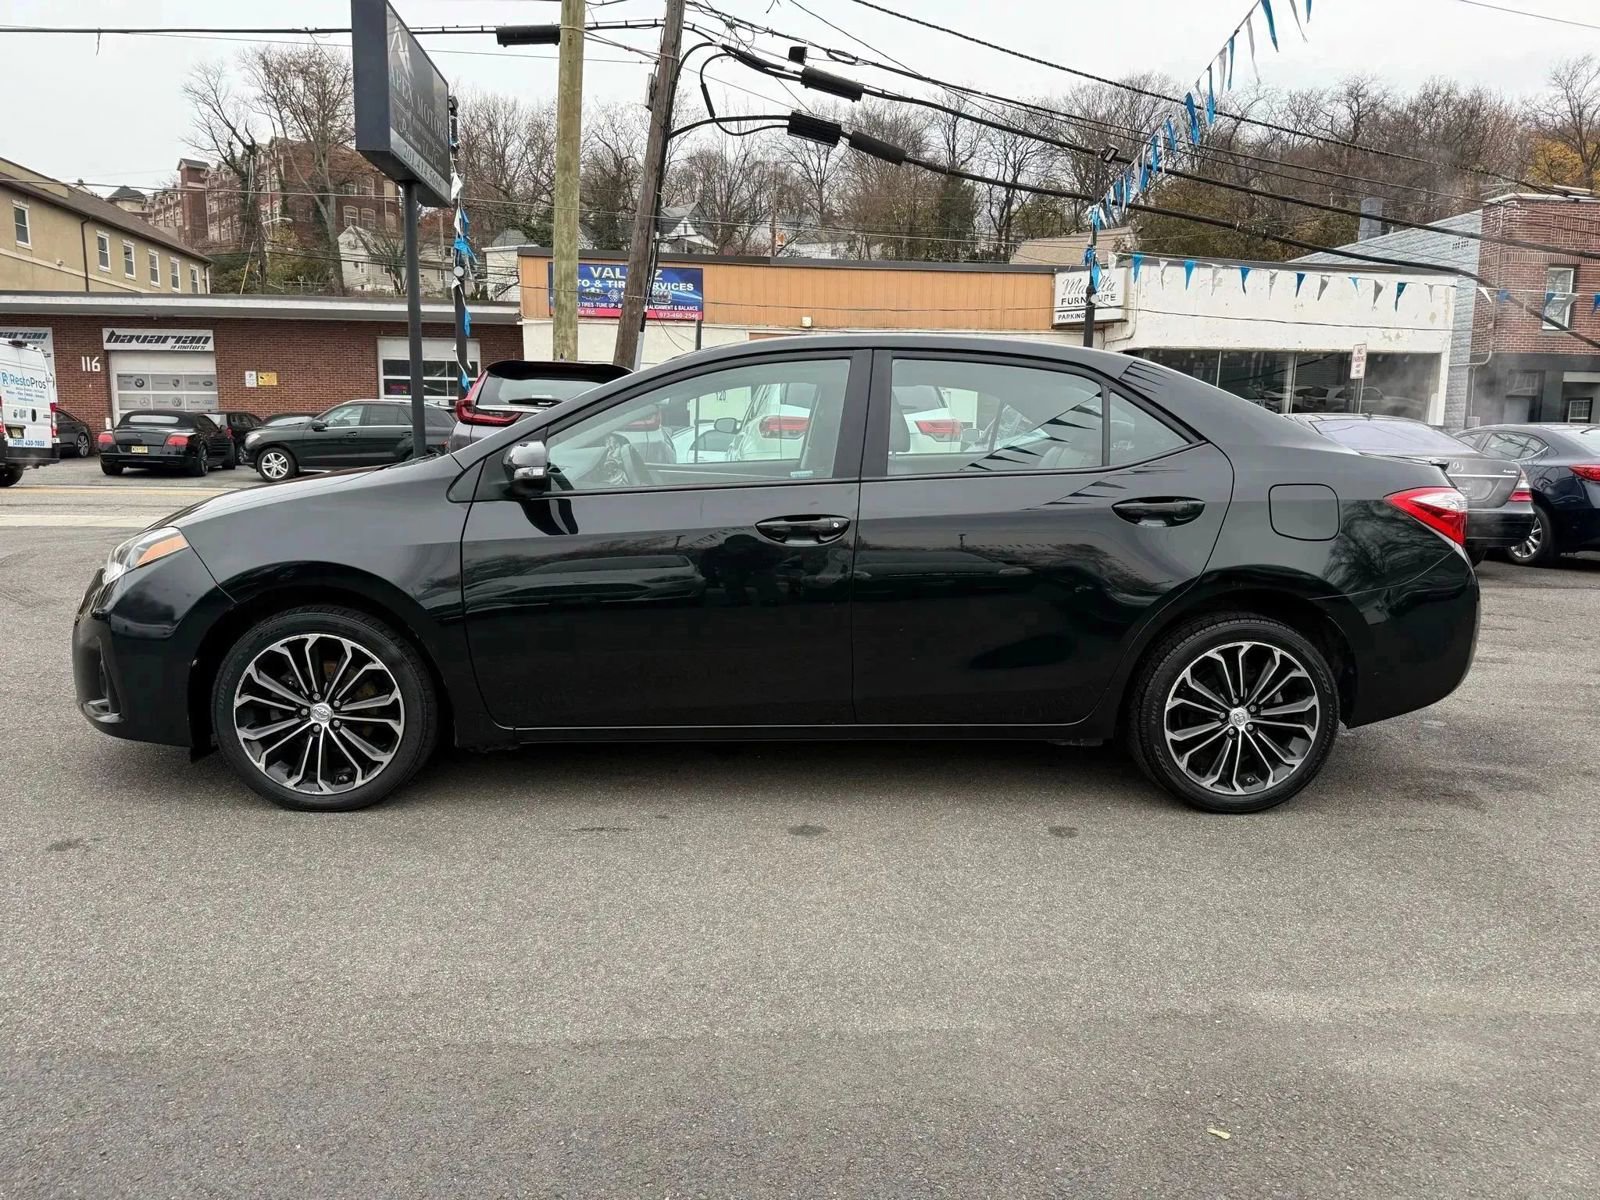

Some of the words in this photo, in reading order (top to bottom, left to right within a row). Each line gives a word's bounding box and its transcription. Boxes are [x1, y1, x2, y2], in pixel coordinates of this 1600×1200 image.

[589, 266, 663, 280] VALZ
[606, 280, 626, 288] TIR
[652, 281, 694, 291] RVICES
[1060, 293, 1117, 306] FURNURE
[1057, 312, 1086, 320] PARKING
[105, 329, 212, 344] bavarian
[81, 356, 101, 372] 116
[9, 373, 47, 389] RestoPros
